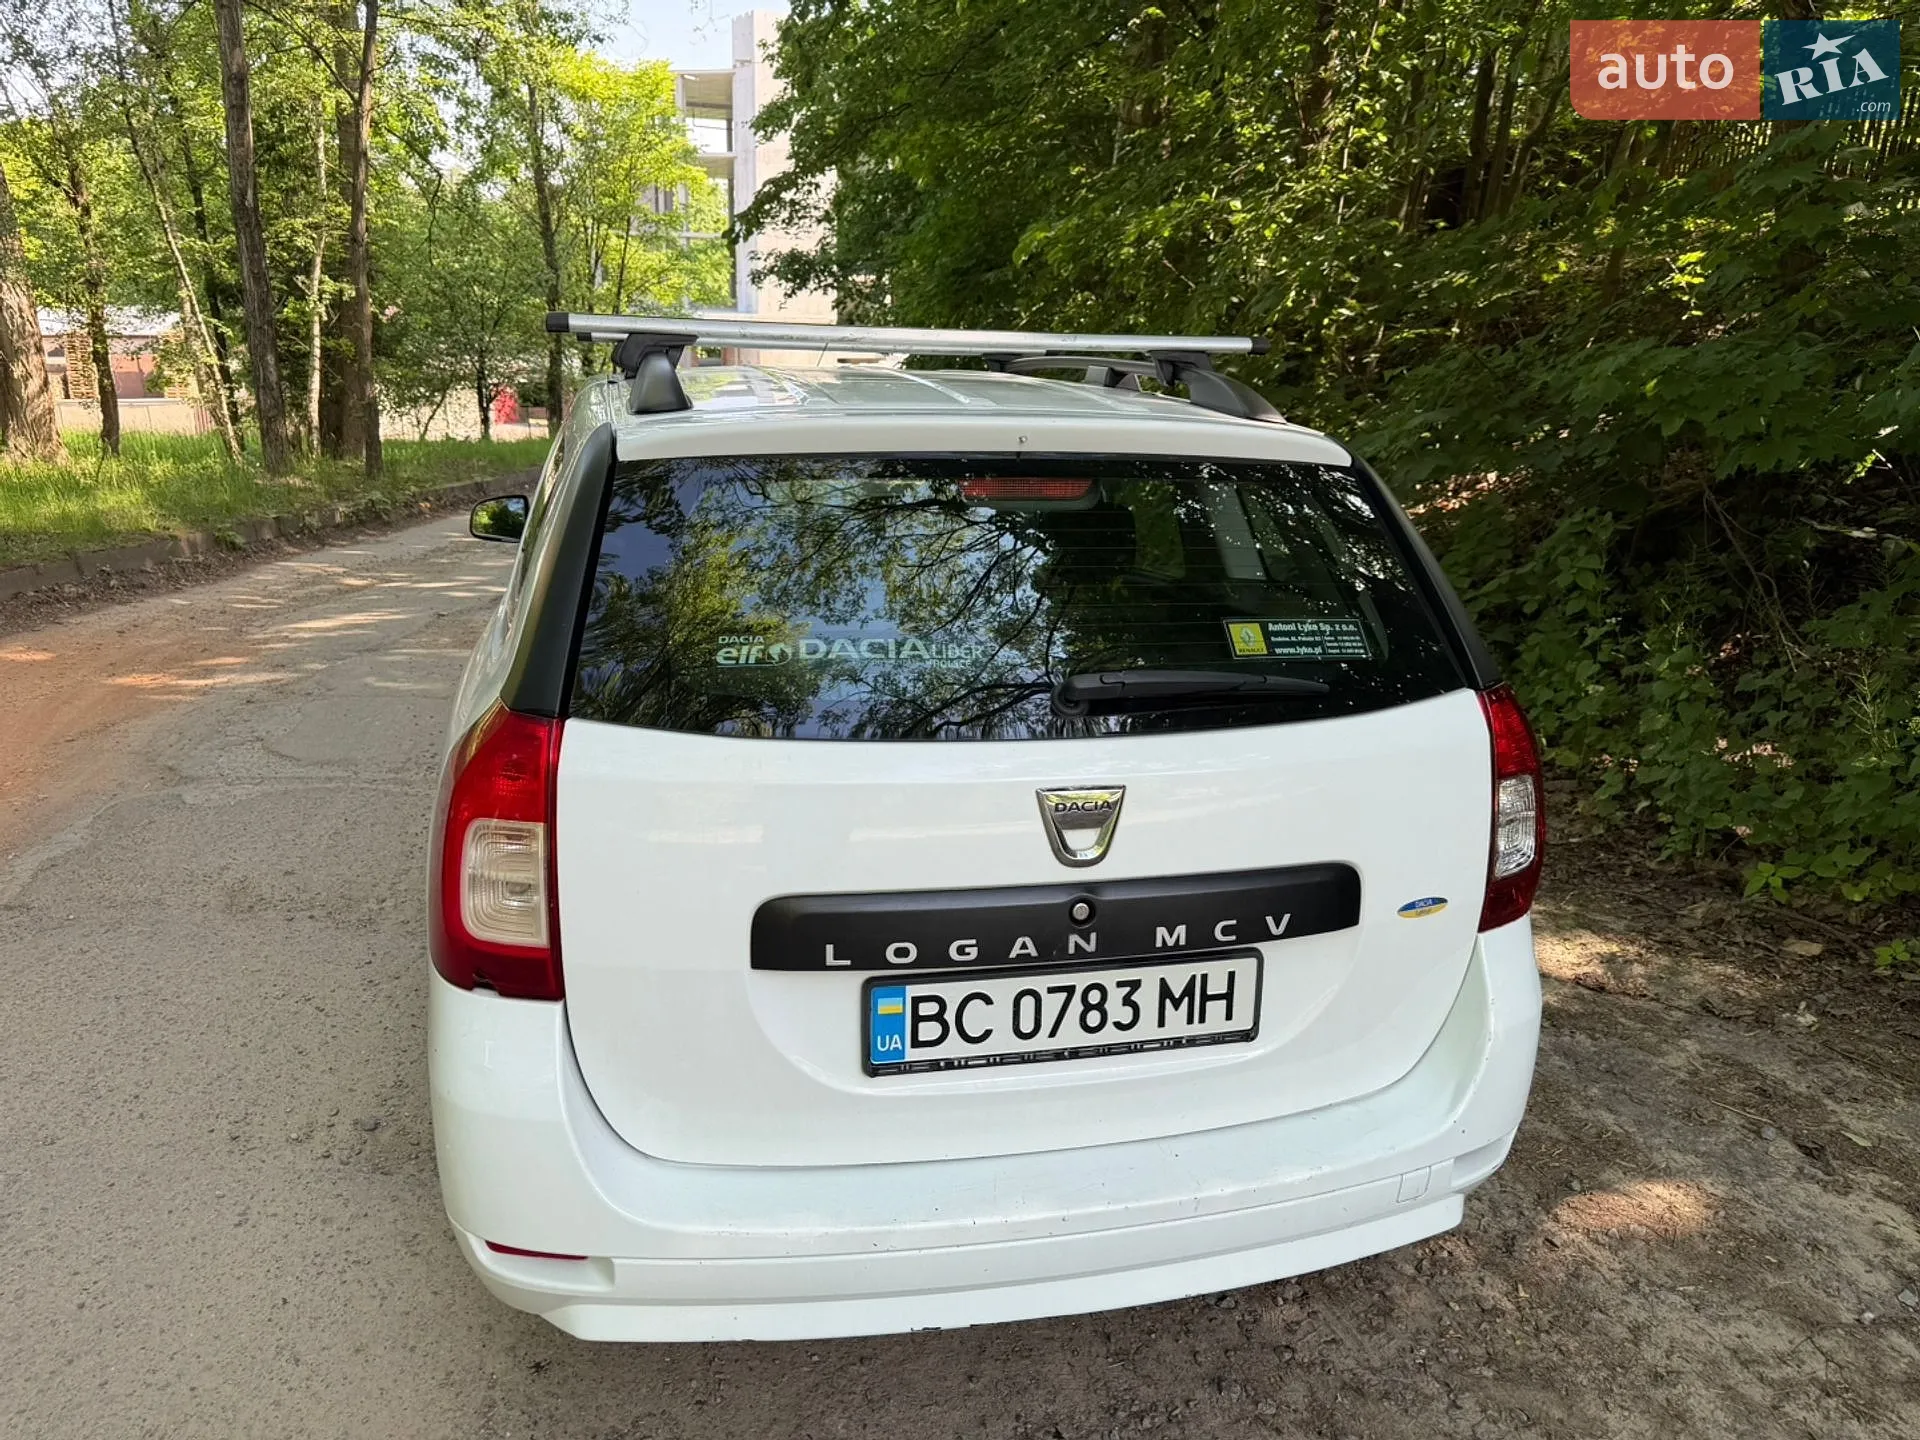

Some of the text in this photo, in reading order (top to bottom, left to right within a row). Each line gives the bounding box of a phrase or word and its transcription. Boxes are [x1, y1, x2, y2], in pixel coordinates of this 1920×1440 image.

[716, 645, 764, 664] elf
[800, 638, 929, 659] DACIA
[1054, 800, 1112, 812] DACIA
[825, 913, 1291, 966] LOGAN MCV
[910, 970, 1236, 1048] BC 0783 MH
[876, 1034, 903, 1053] UA
